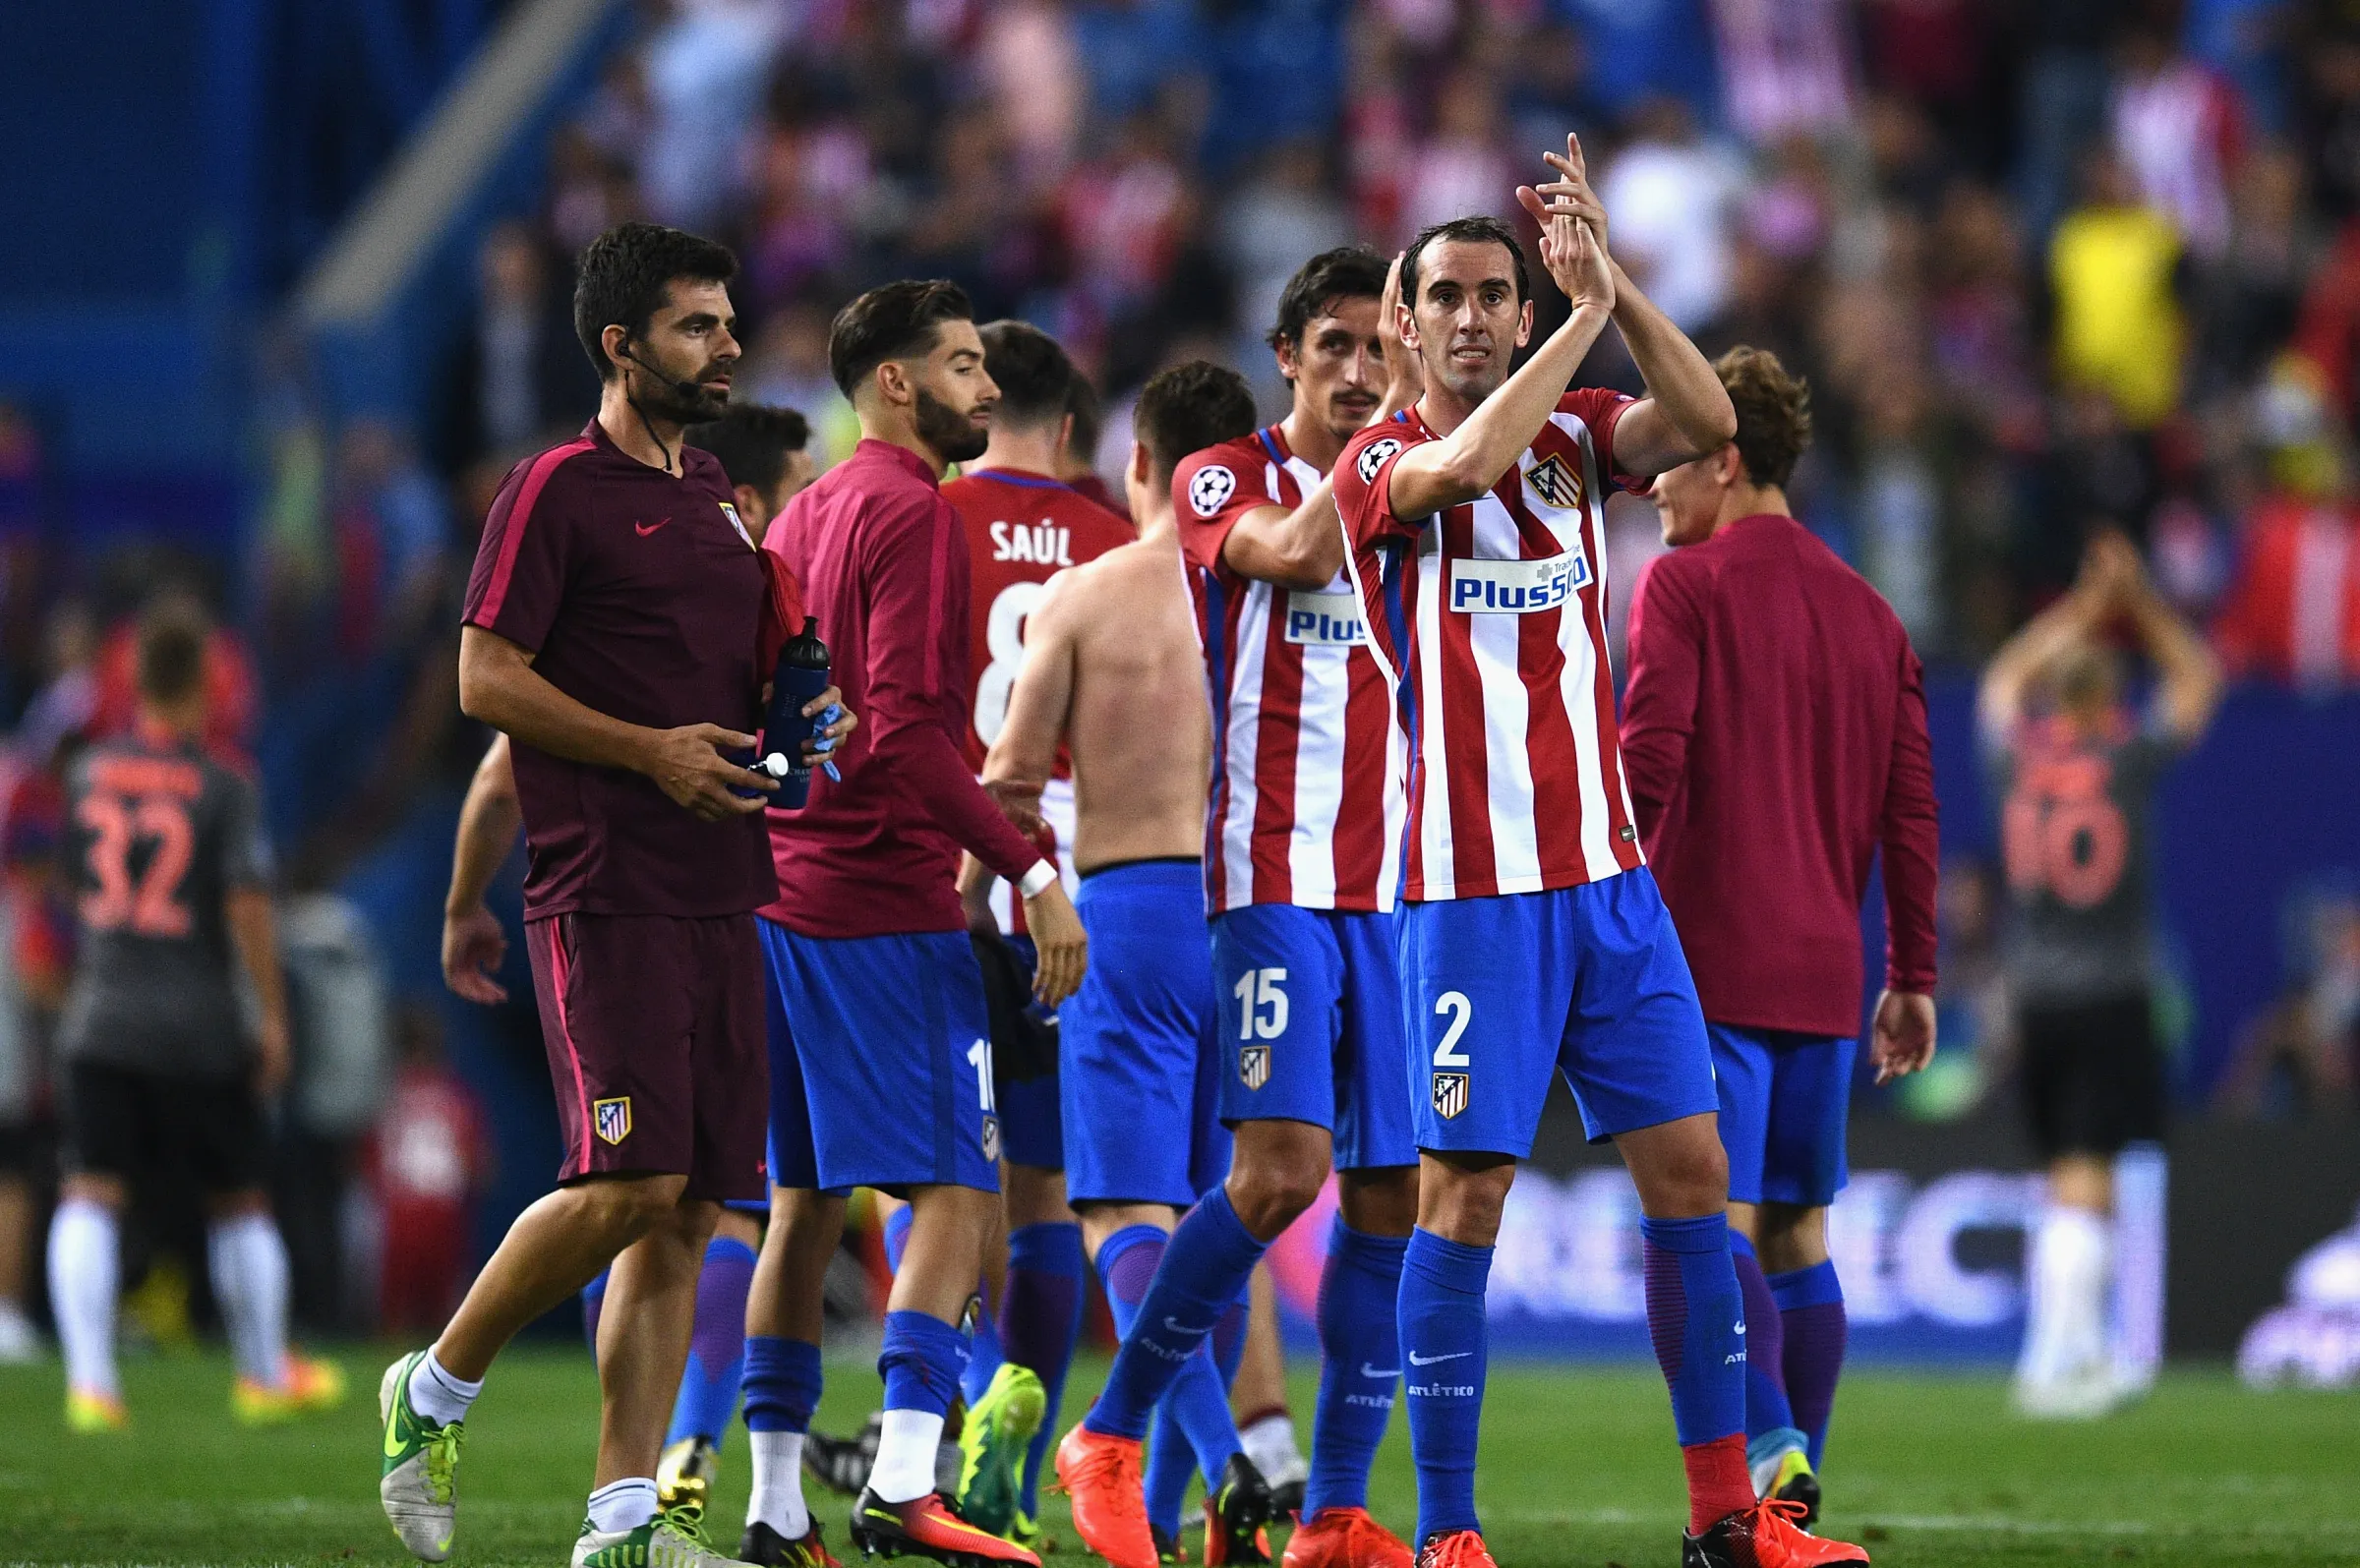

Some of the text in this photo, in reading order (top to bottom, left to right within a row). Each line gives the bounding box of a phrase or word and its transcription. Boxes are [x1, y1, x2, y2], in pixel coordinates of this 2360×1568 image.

[989, 517, 1074, 566] SAÚL
[1454, 555, 1587, 608] Plus500
[1234, 967, 1289, 1040] 15
[1433, 990, 1472, 1067] 2
[967, 1037, 995, 1113] 1
[1408, 1382, 1474, 1396] ATLÉTICO
